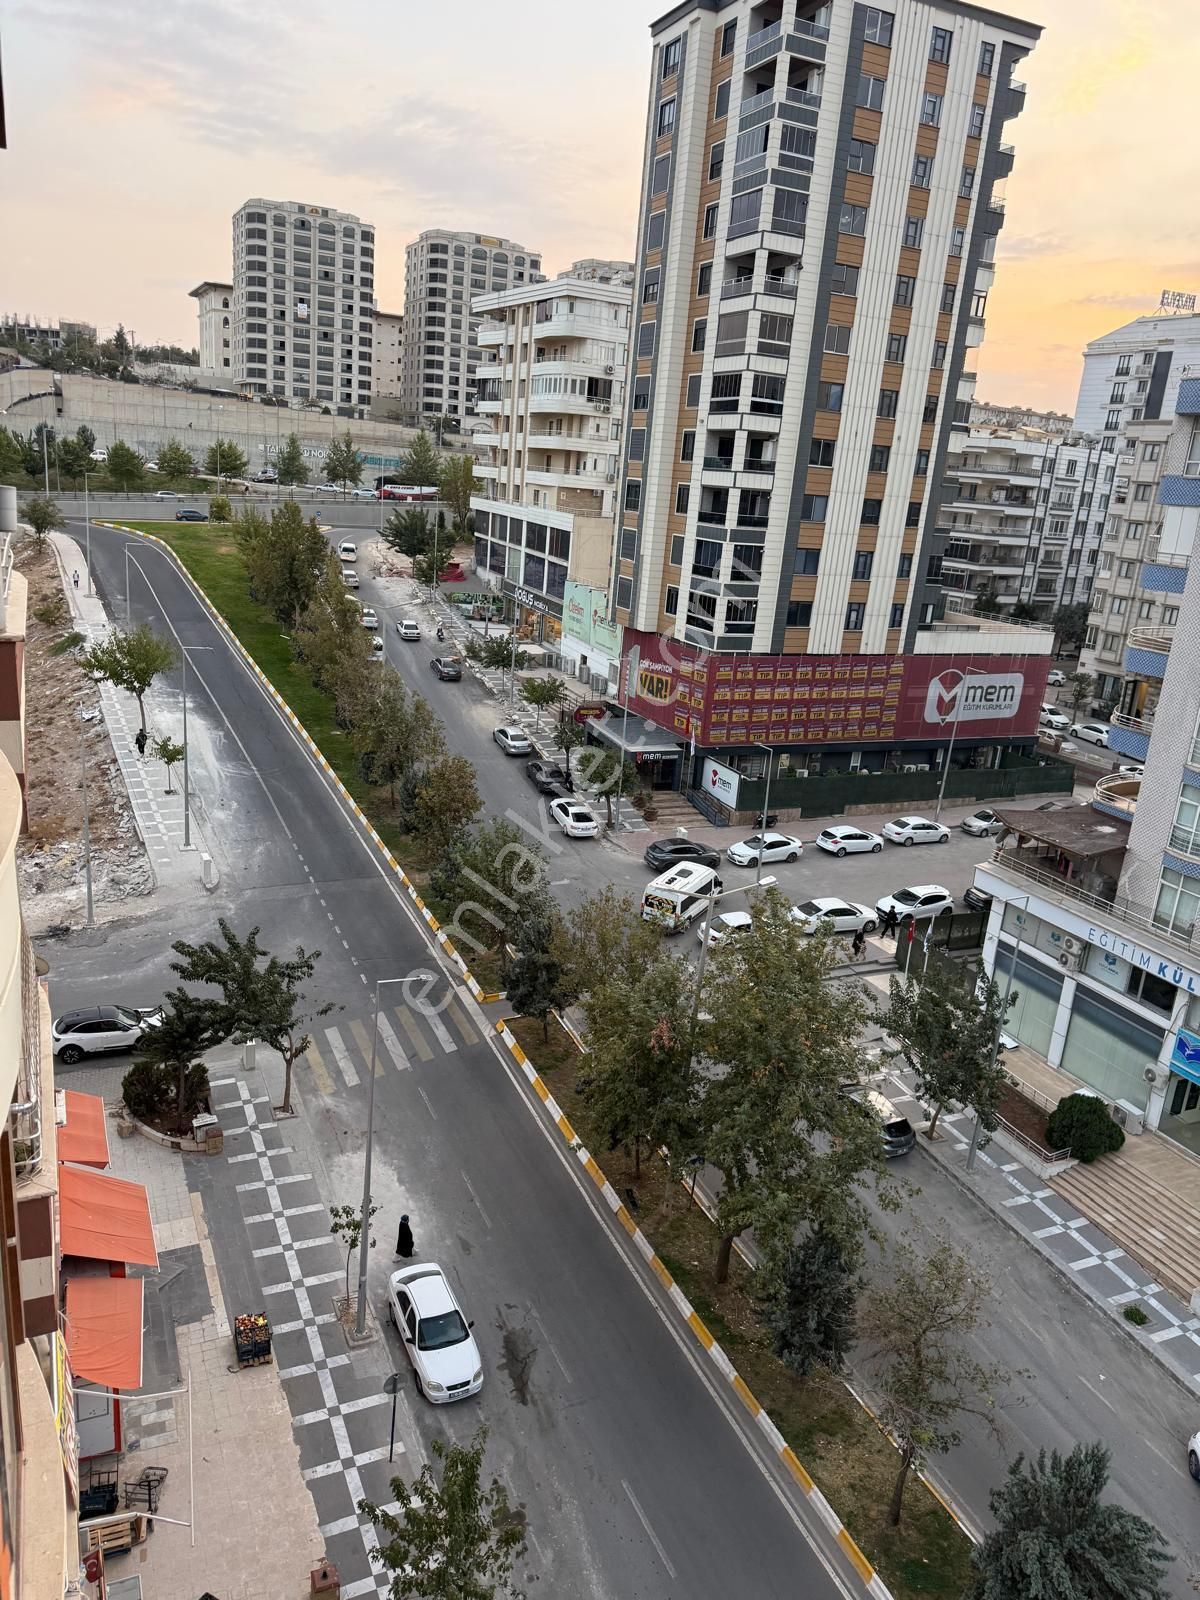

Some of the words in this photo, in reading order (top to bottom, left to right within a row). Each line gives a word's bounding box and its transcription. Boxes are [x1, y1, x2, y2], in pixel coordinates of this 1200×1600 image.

[640, 671, 669, 700] VAR!
[965, 684, 1015, 703] mem
[963, 703, 982, 711] EĞİTİM
[718, 777, 732, 791] mem
[1087, 927, 1153, 970] EĞİTİM
[1157, 961, 1196, 992] KÜL
